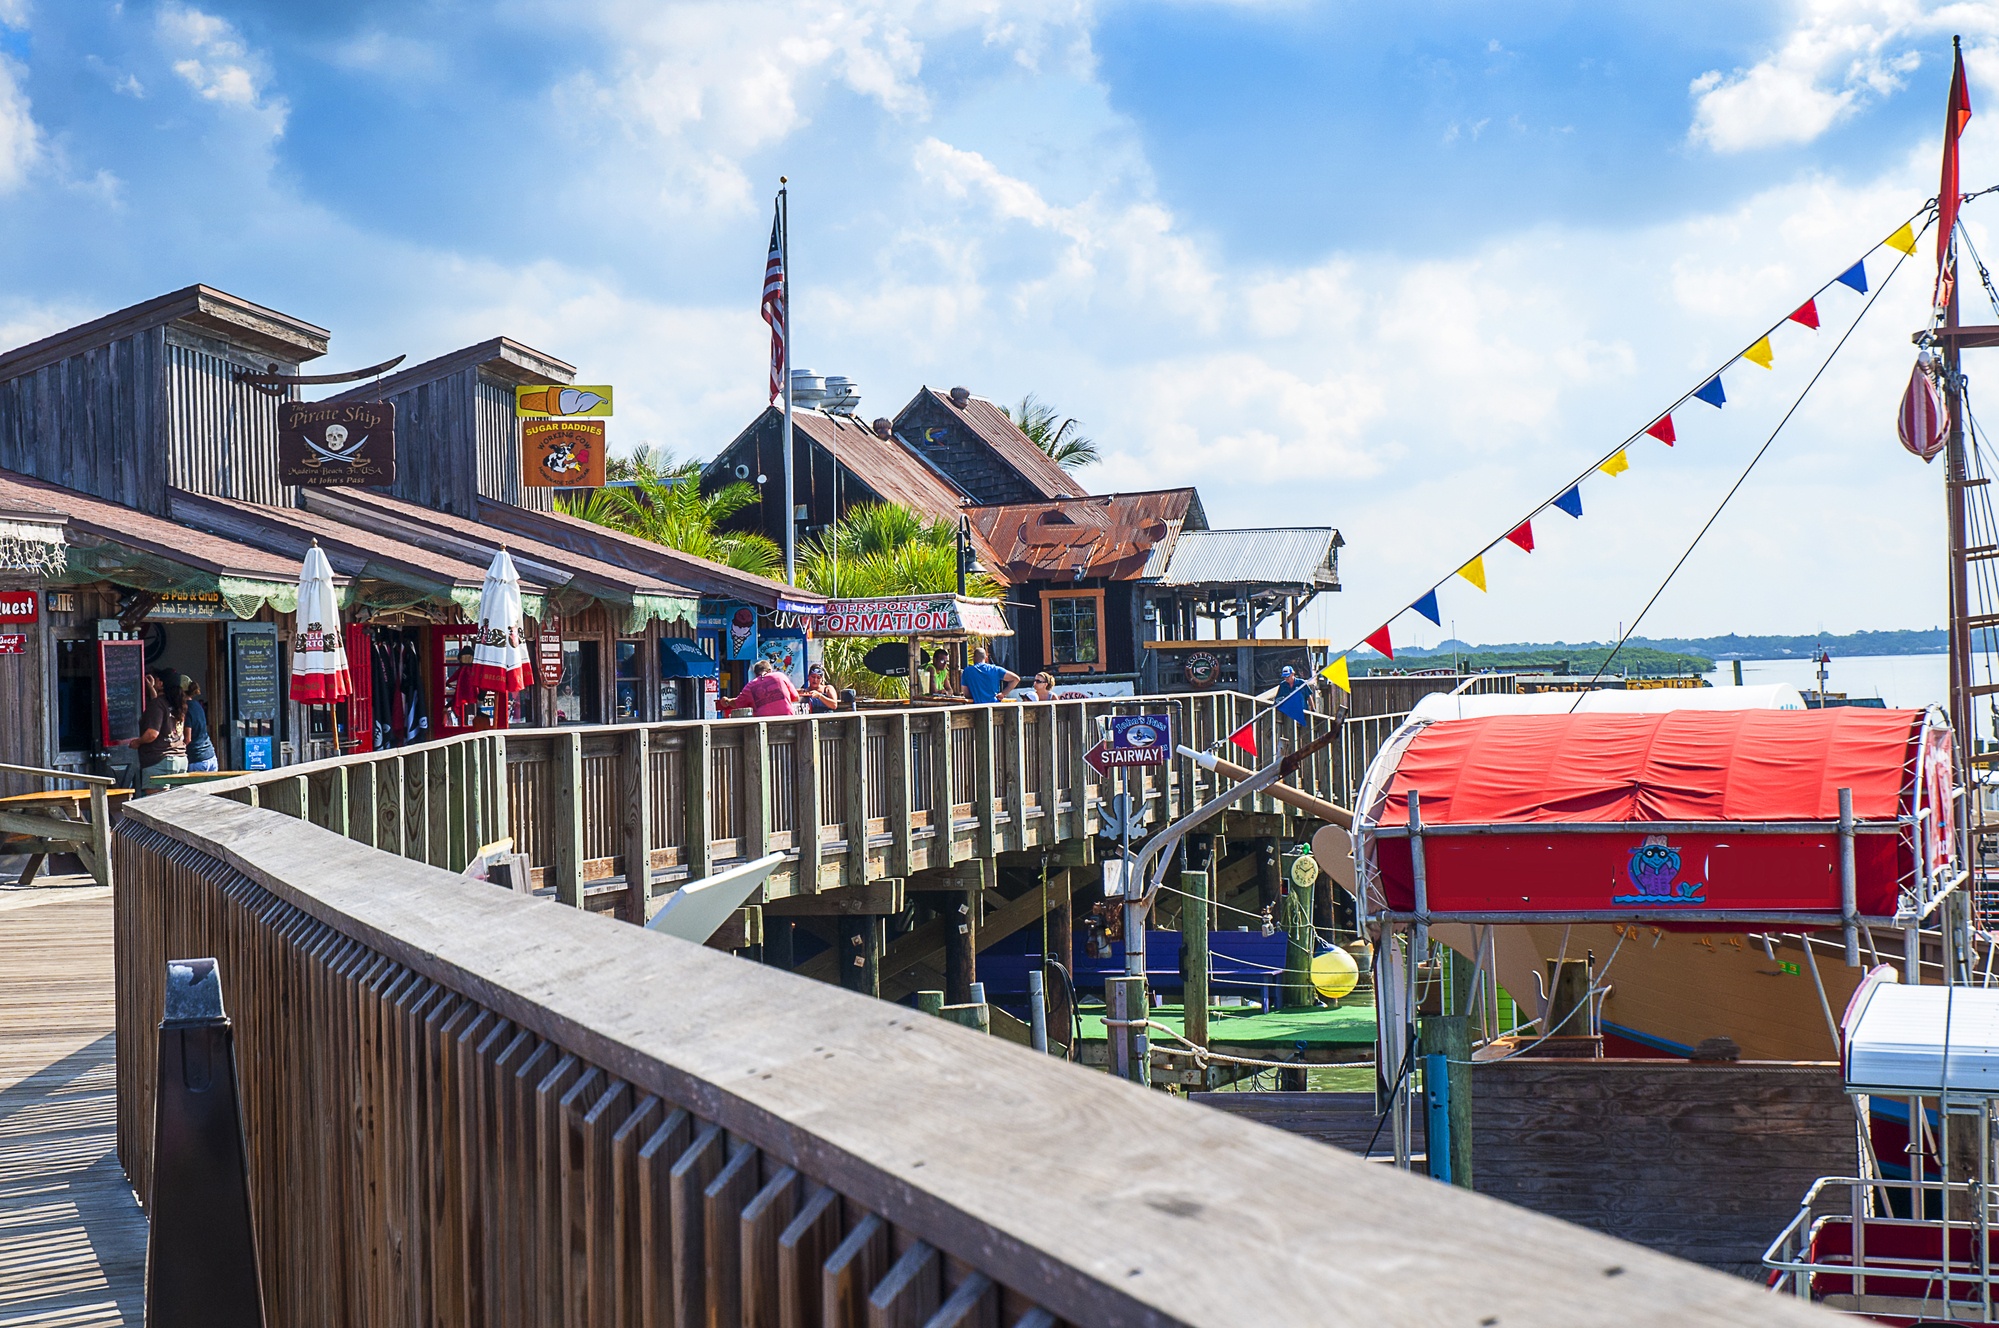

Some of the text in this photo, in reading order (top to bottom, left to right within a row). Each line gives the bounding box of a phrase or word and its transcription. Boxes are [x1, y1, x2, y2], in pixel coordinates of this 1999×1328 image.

[289, 406, 381, 429] Pirate Ship
[525, 423, 602, 436] SUGAR DADDIES
[537, 431, 592, 450] WORKING COW
[288, 467, 319, 476] Madeira
[361, 467, 383, 475] USA
[538, 466, 564, 486] HOMEMADE
[319, 477, 344, 485] John's
[171, 590, 188, 601] Pub
[190, 589, 197, 601] &
[198, 590, 219, 602] Grub
[0, 597, 34, 616] uest
[161, 602, 176, 613] Food
[176, 603, 188, 614] For
[825, 601, 930, 613] ATERSPORTS
[793, 611, 948, 632] FORMATION
[783, 645, 795, 657] COW
[1115, 716, 1167, 735] John's Pass
[1101, 748, 1159, 763] STAIRWAY
